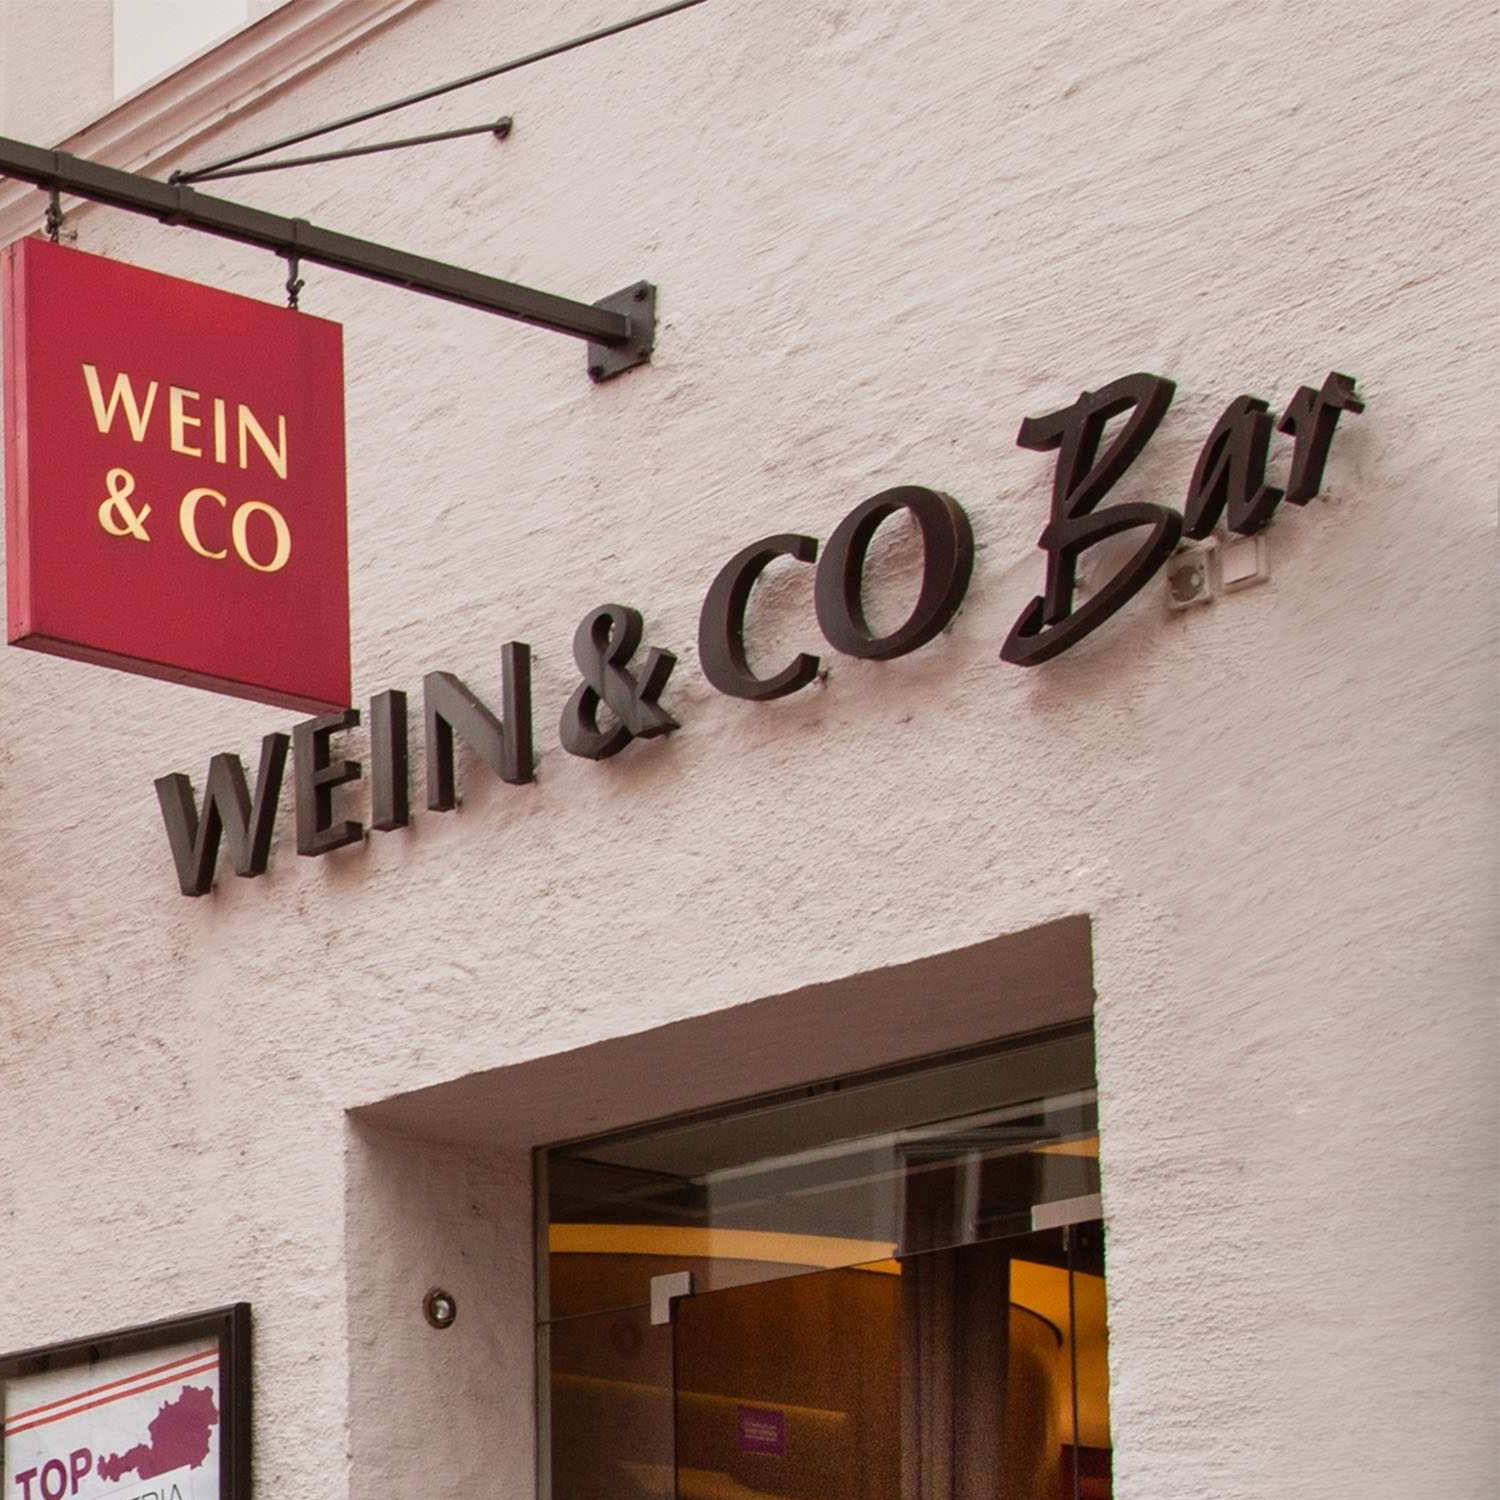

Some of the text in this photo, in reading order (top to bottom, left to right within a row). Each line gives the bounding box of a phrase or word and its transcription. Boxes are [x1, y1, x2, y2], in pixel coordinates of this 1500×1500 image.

[81, 362, 289, 480] WEIN
[97, 467, 293, 575] & CO
[154, 371, 1365, 896] WEIN & CO Bar
